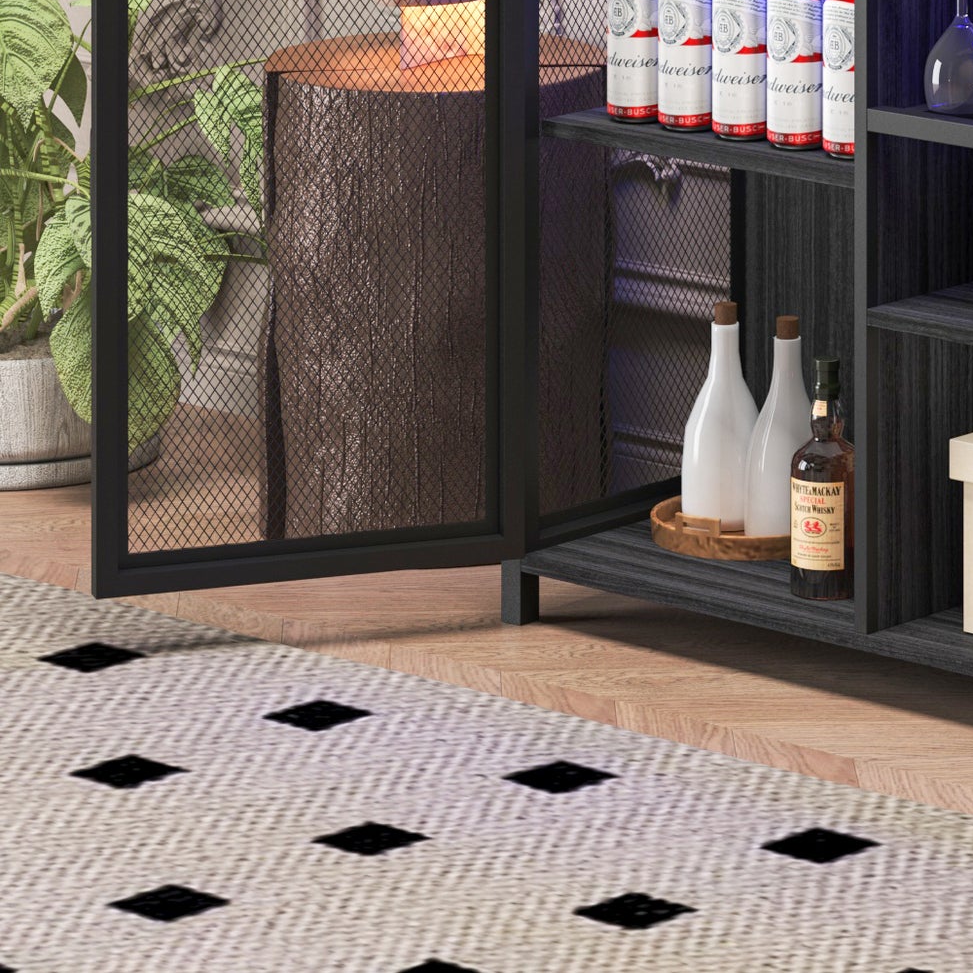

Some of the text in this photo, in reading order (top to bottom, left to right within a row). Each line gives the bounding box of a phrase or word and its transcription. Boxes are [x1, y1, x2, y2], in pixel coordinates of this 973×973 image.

[608, 52, 658, 68] dweiser
[659, 60, 712, 76] dweiser
[714, 68, 767, 84] dweiser
[767, 77, 822, 94] dweiser
